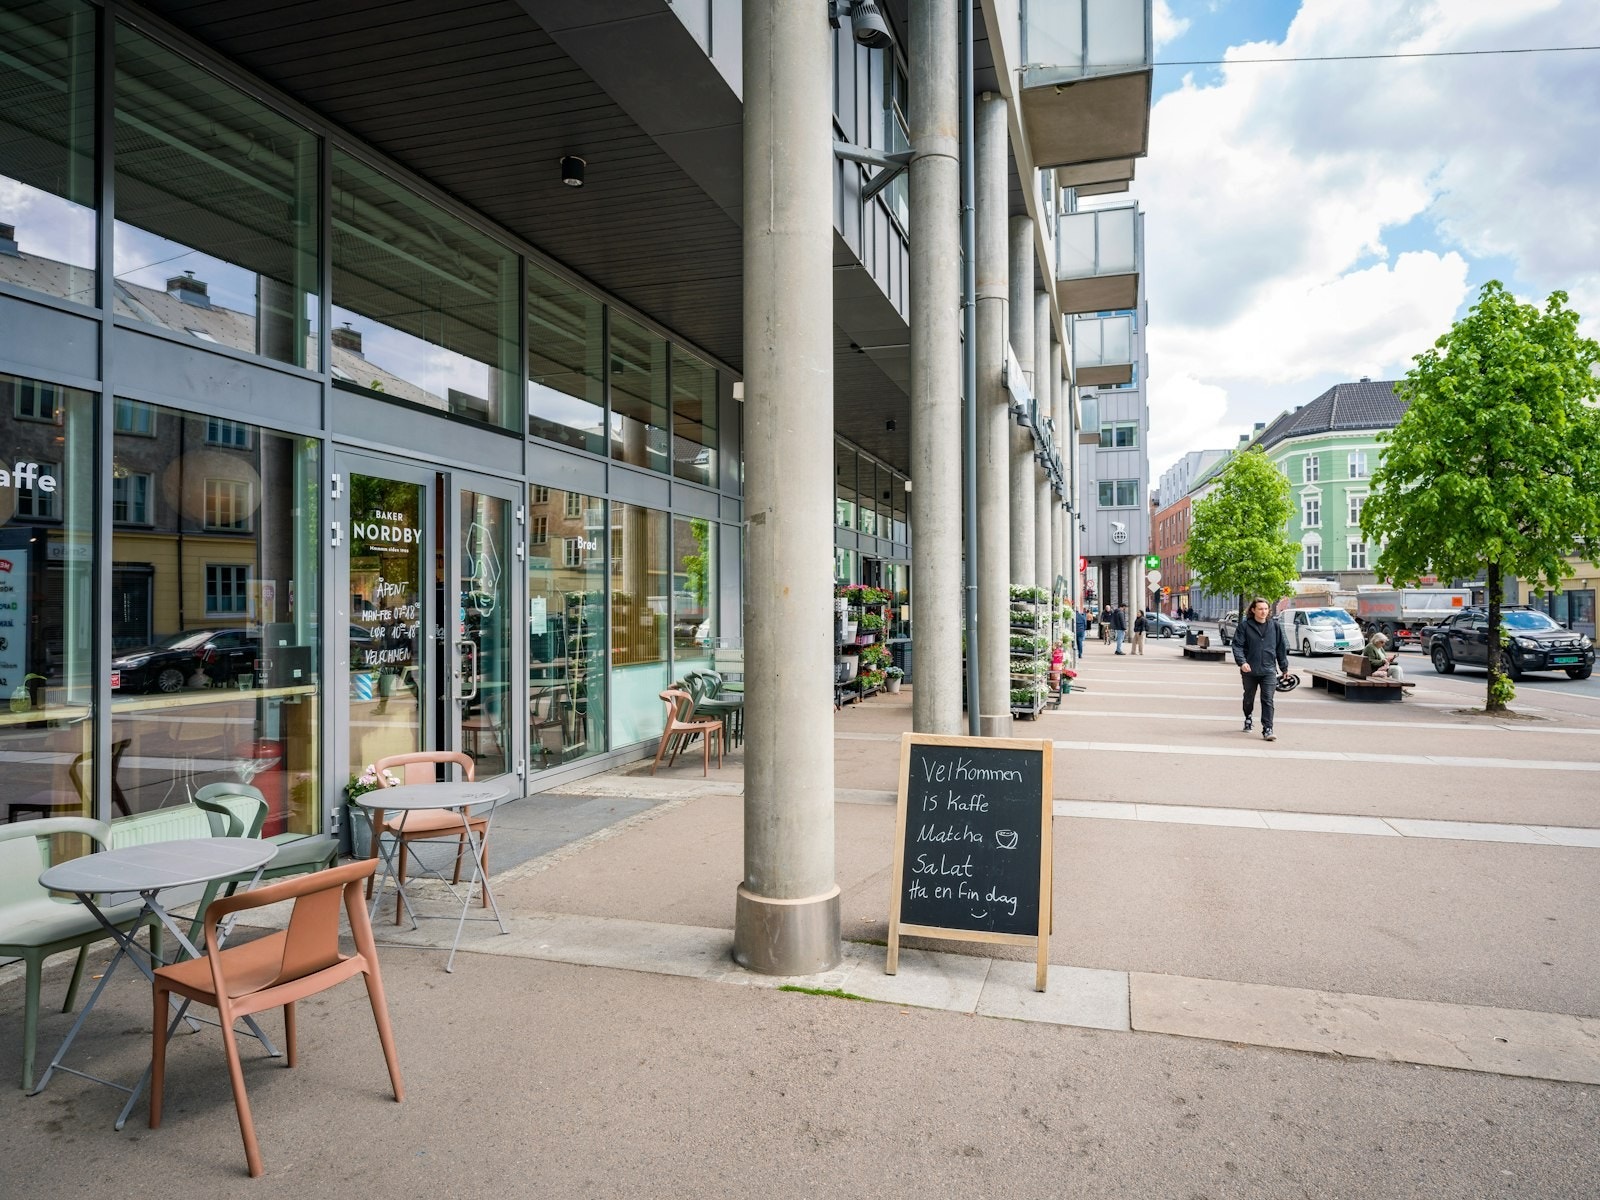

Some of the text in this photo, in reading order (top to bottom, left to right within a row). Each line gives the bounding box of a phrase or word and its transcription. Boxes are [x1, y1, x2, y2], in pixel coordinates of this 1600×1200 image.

[0, 461, 57, 492] affe
[375, 510, 403, 521] BAKER
[353, 522, 422, 544] NORDBY
[577, 535, 597, 551] Brød
[376, 576, 409, 598] ÅPENT
[370, 626, 386, 638] LØR
[921, 757, 1023, 783] Velkommen
[916, 824, 984, 843] Matcha
[911, 853, 973, 877] Salat
[908, 878, 1018, 916] Ha en fin dag
